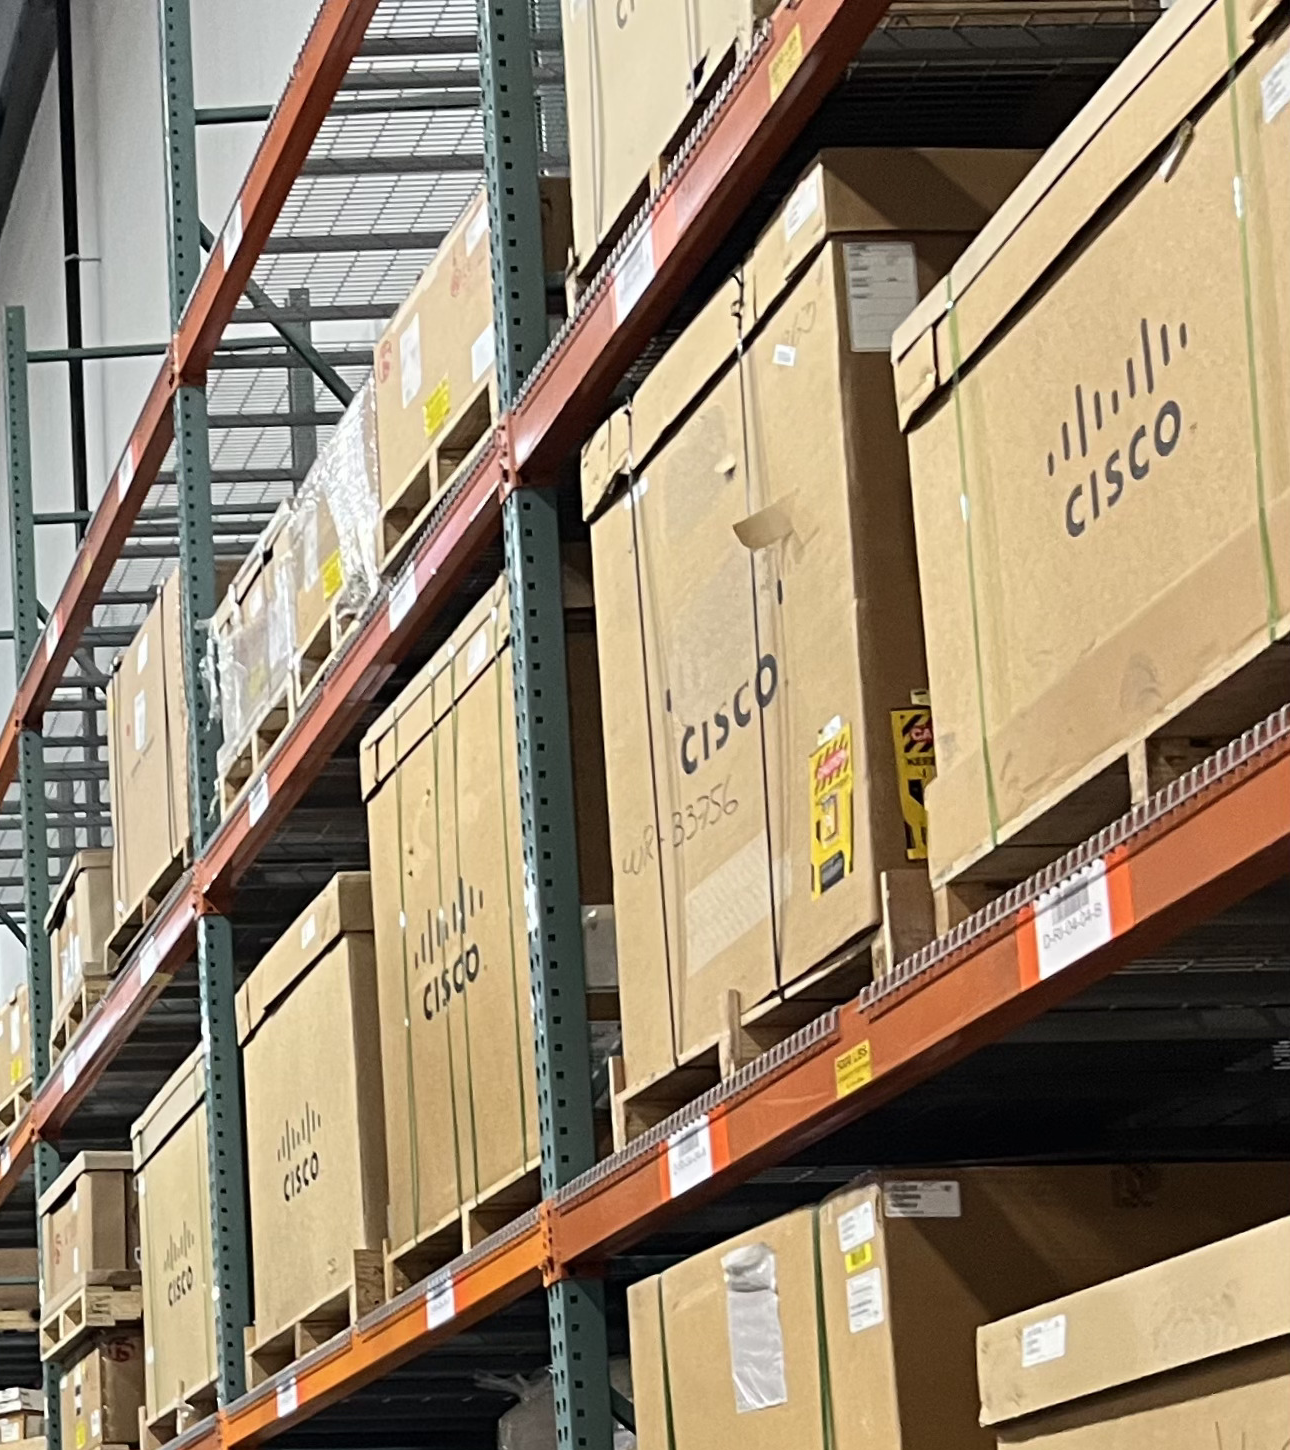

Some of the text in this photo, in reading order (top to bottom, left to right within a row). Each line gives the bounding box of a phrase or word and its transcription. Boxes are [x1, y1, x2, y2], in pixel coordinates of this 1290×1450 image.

[1064, 400, 1182, 538] CISCO
[681, 653, 778, 775] CISCO
[423, 944, 481, 1021] CISCO
[283, 1151, 320, 1203] CISCO
[167, 1265, 194, 1308] CISCO
